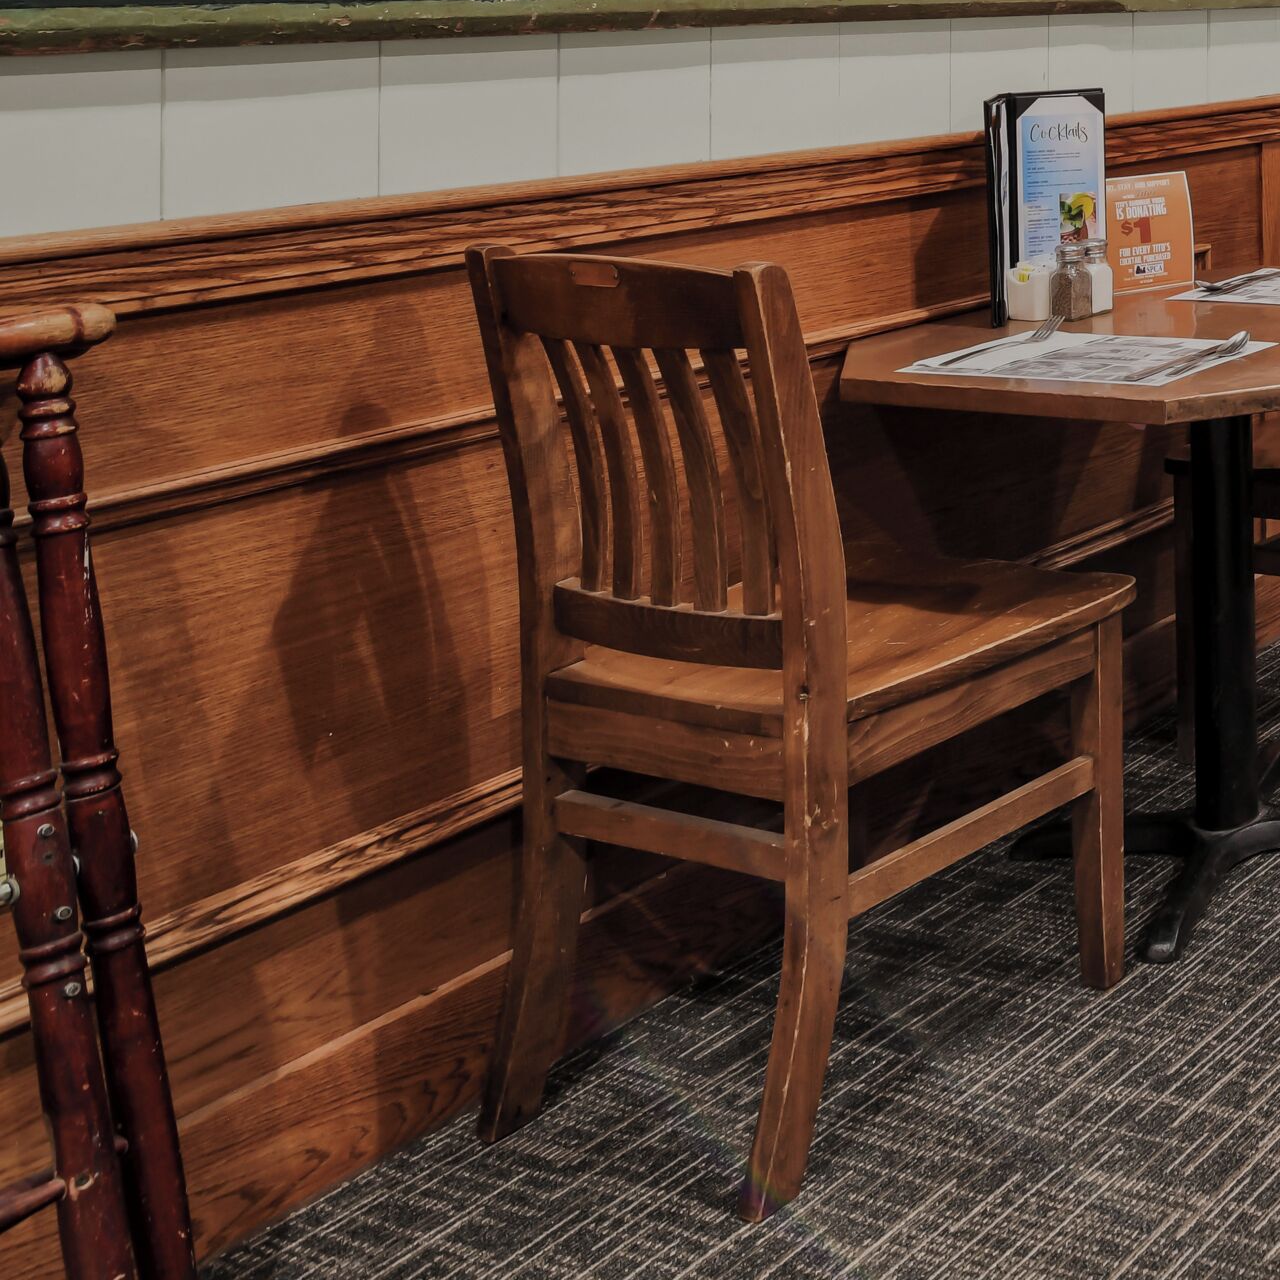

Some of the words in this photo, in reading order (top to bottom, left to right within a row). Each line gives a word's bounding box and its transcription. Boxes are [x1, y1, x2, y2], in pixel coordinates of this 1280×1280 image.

[1116, 207, 1125, 220] IS
[1126, 203, 1168, 219] DONATING
[1120, 216, 1152, 244] $1
[1132, 245, 1151, 256] EVERY
